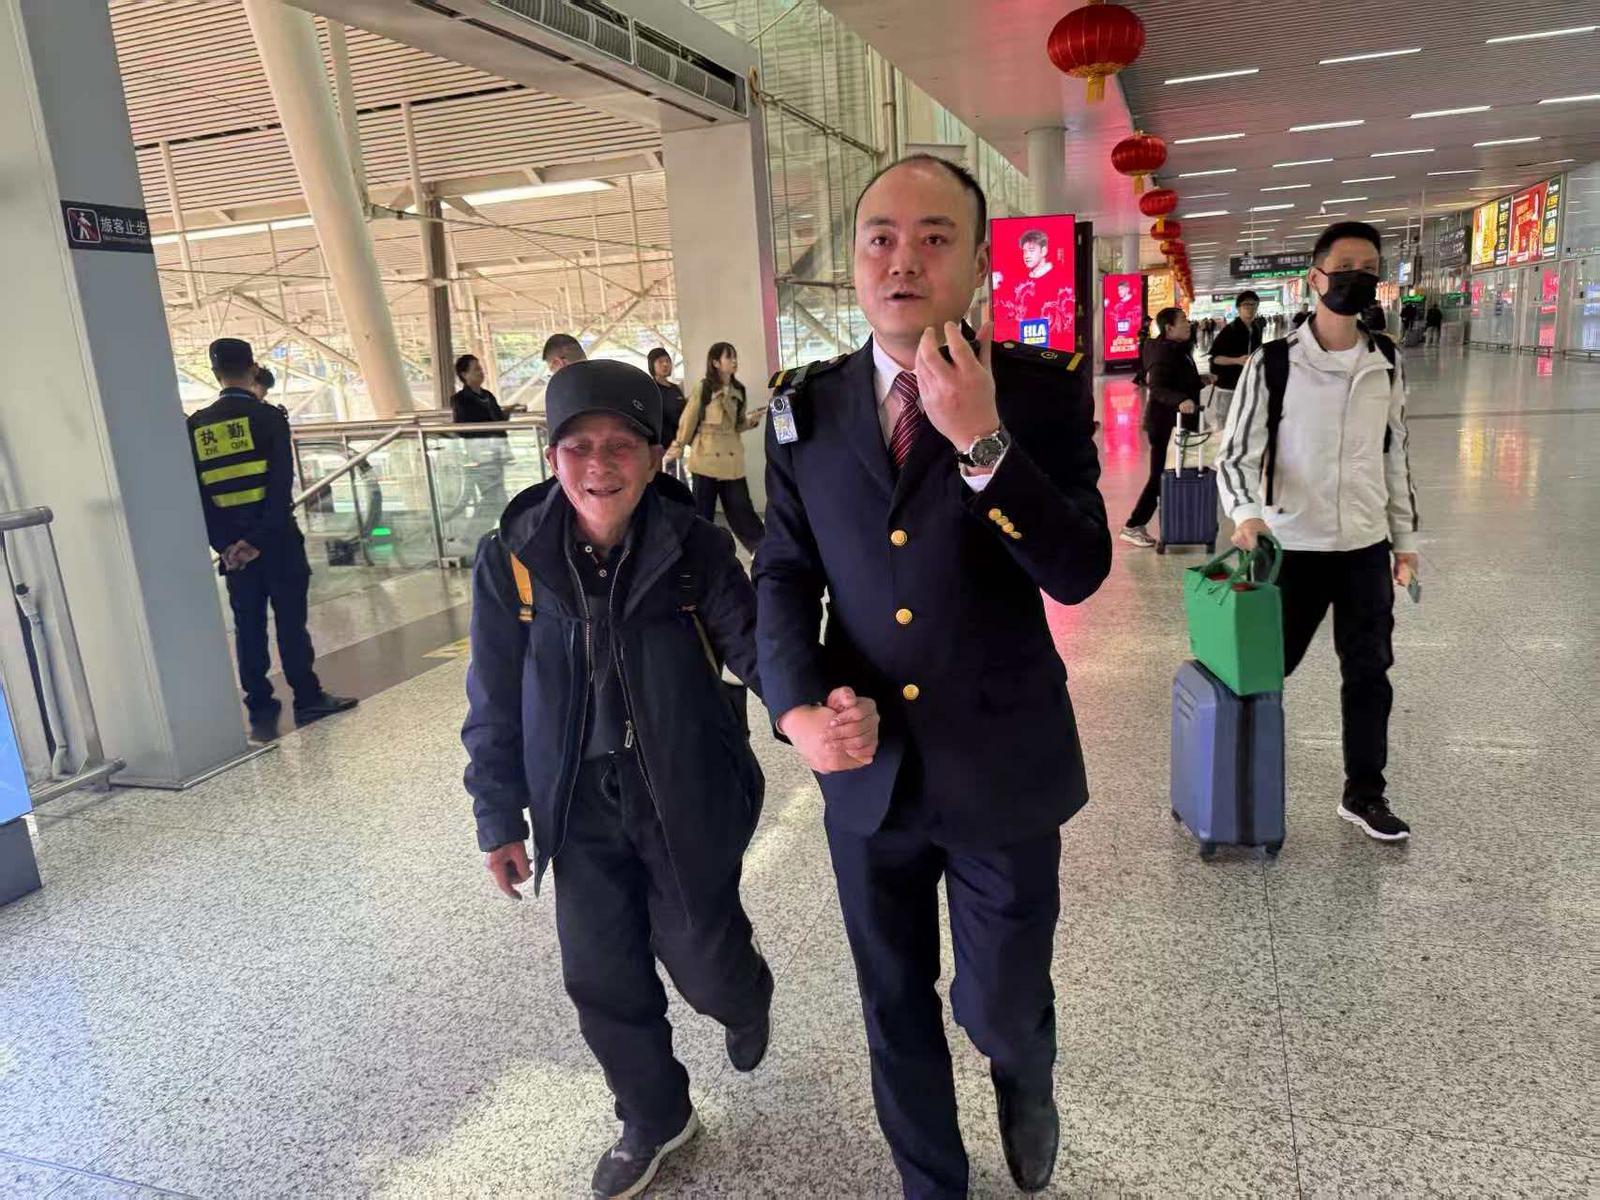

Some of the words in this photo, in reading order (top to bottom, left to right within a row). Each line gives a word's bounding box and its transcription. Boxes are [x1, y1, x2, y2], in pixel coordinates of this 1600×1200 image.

[100, 216, 147, 235] 旅客止步
[1023, 324, 1046, 338] HLA
[200, 422, 245, 446] 执勤
